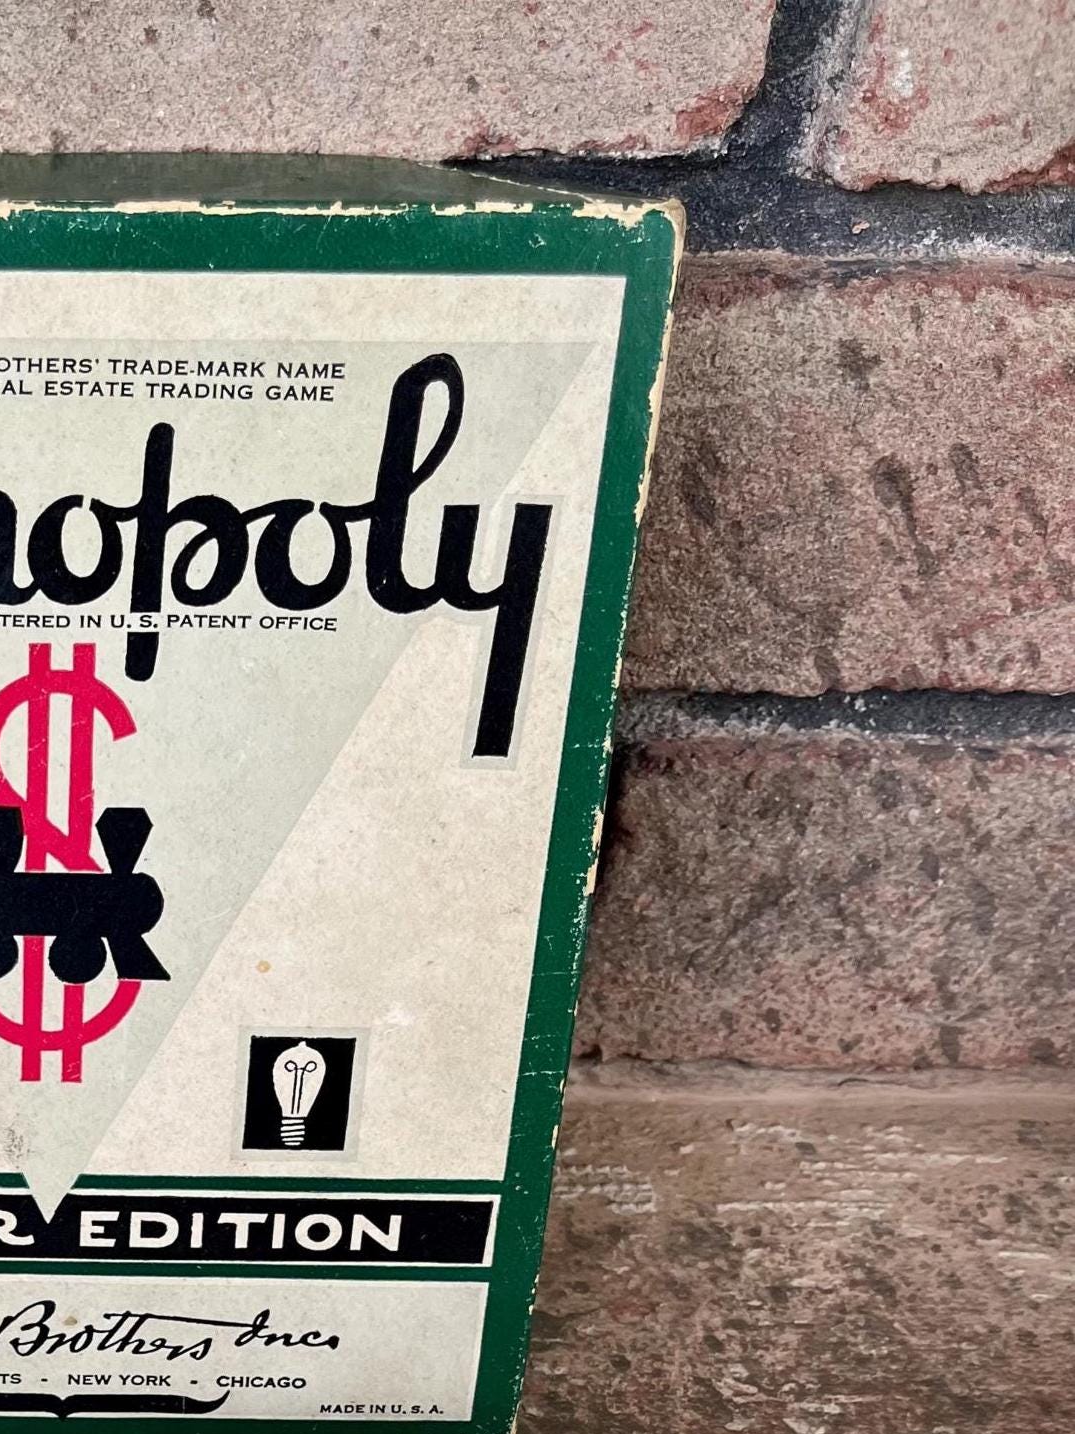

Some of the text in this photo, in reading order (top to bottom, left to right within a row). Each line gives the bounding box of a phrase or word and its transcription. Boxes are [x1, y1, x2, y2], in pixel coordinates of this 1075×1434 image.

[108, 356, 268, 378] TRADE-MARK
[275, 361, 347, 381] NAME
[43, 380, 135, 398] ESTATE
[145, 383, 255, 401] TRADING
[265, 385, 336, 402] GAME
[79, 613, 103, 630] IN
[166, 614, 253, 631] PATENT
[259, 615, 339, 633] OFFICE
[80, 1210, 404, 1251] EDITION
[66, 1373, 114, 1388] NEW
[119, 1374, 172, 1388] YORK
[215, 1375, 308, 1391] CHICAGO
[319, 1403, 367, 1415] MADE
[371, 1403, 386, 1415] IN
